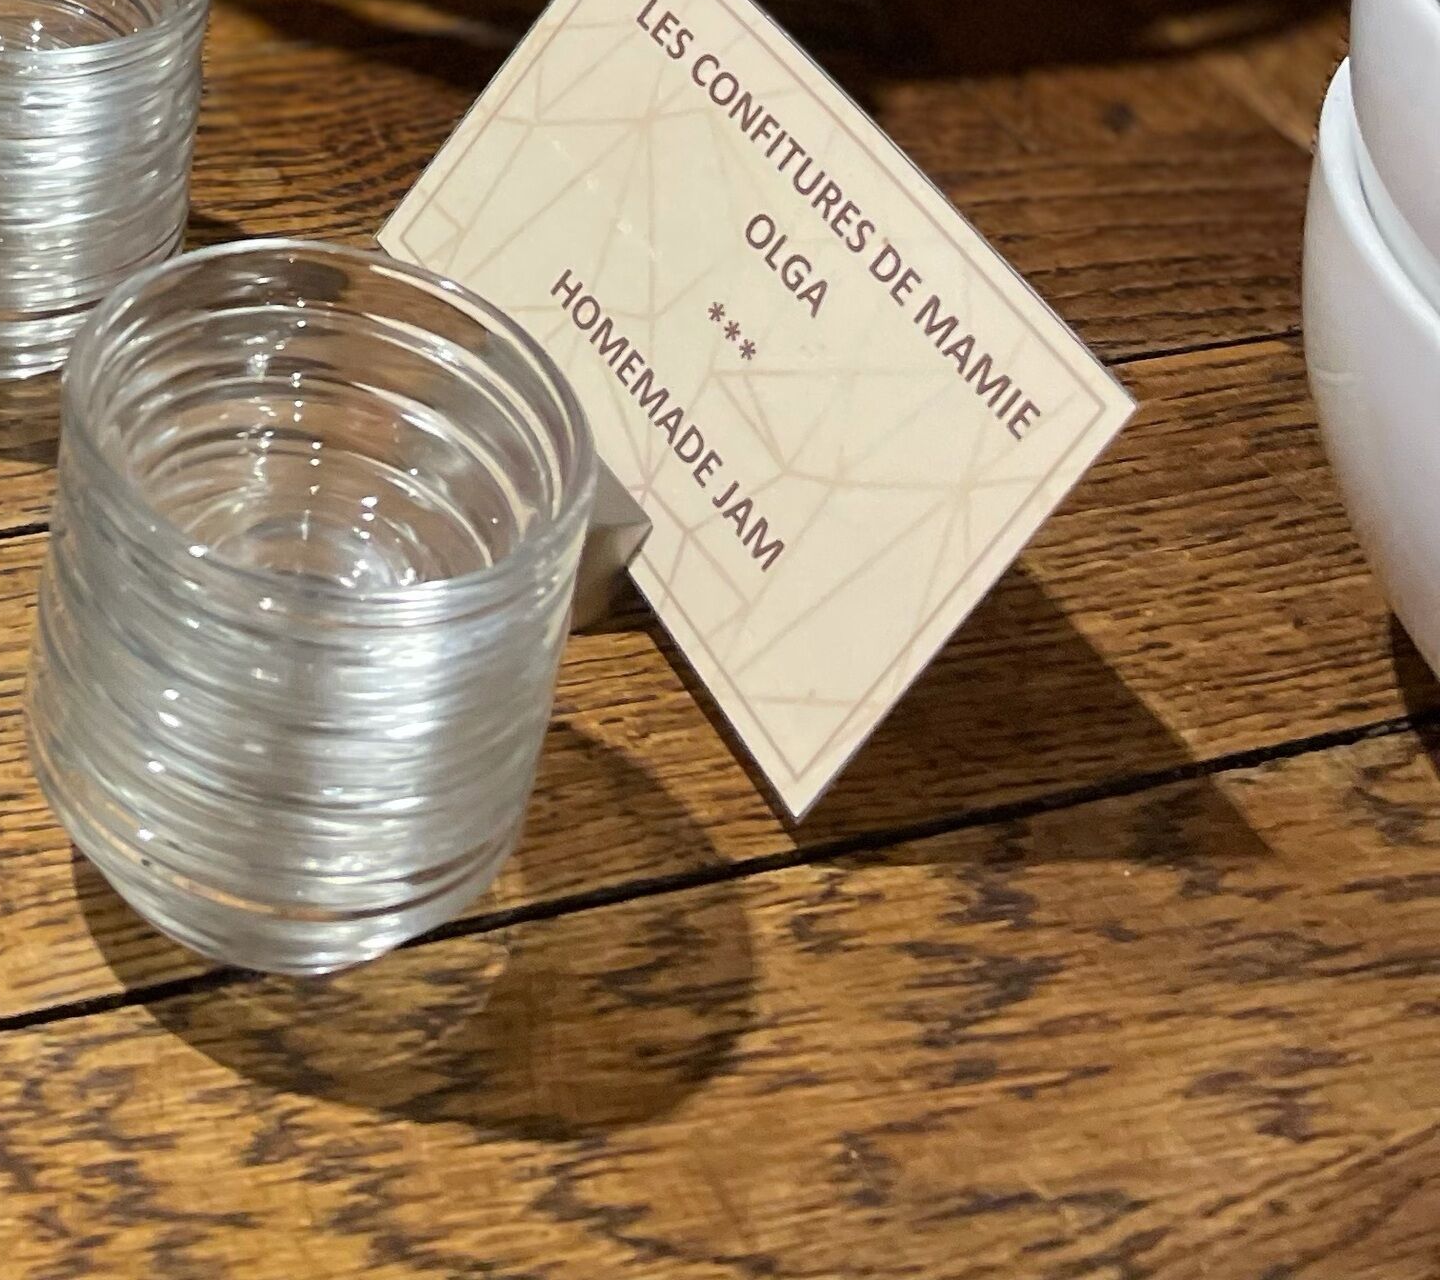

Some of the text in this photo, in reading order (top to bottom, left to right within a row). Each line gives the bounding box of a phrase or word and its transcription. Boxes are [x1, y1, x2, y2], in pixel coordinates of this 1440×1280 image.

[692, 53, 875, 253] CONFITURES
[869, 244, 921, 306] DE
[914, 296, 1042, 440] MAMIE
[745, 214, 829, 319] OLGA
[551, 268, 785, 571] HOMEMADE JAM
